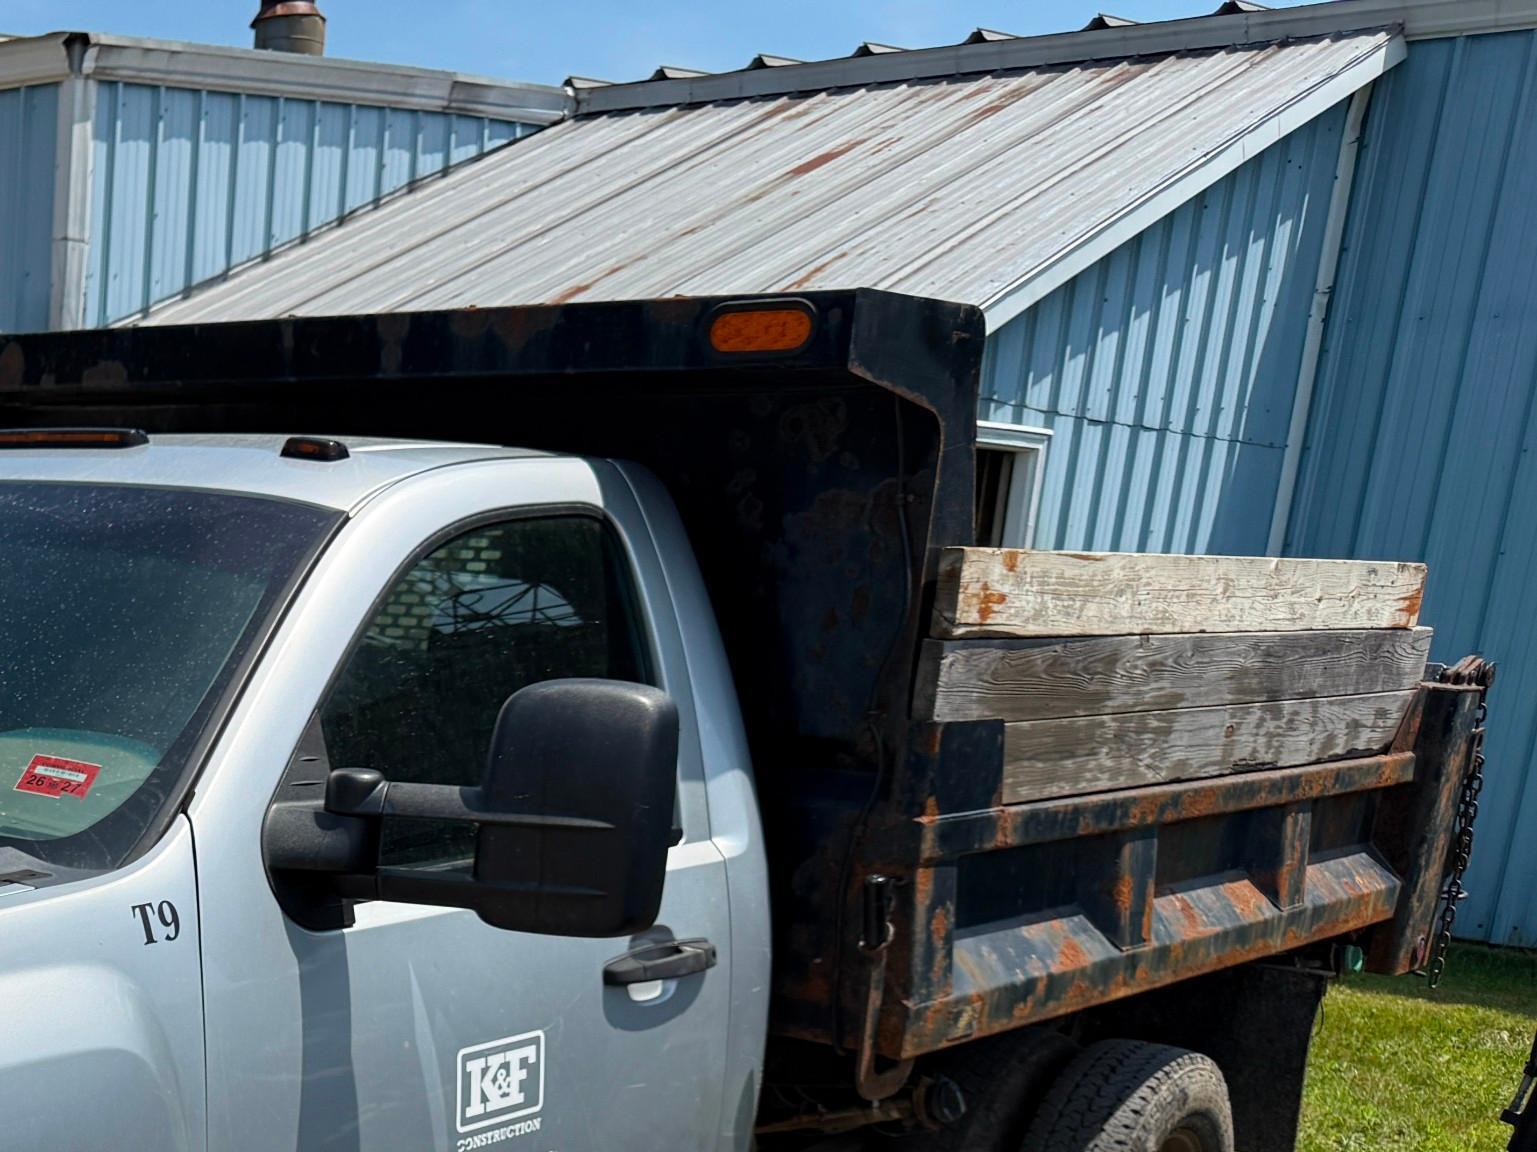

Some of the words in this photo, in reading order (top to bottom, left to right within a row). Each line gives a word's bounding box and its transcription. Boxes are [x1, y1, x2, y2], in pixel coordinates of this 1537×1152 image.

[26, 775, 46, 787] 26
[131, 900, 181, 946] T9
[465, 1044, 537, 1118] K&F
[456, 1117, 543, 1152] CONSTRUCTION
